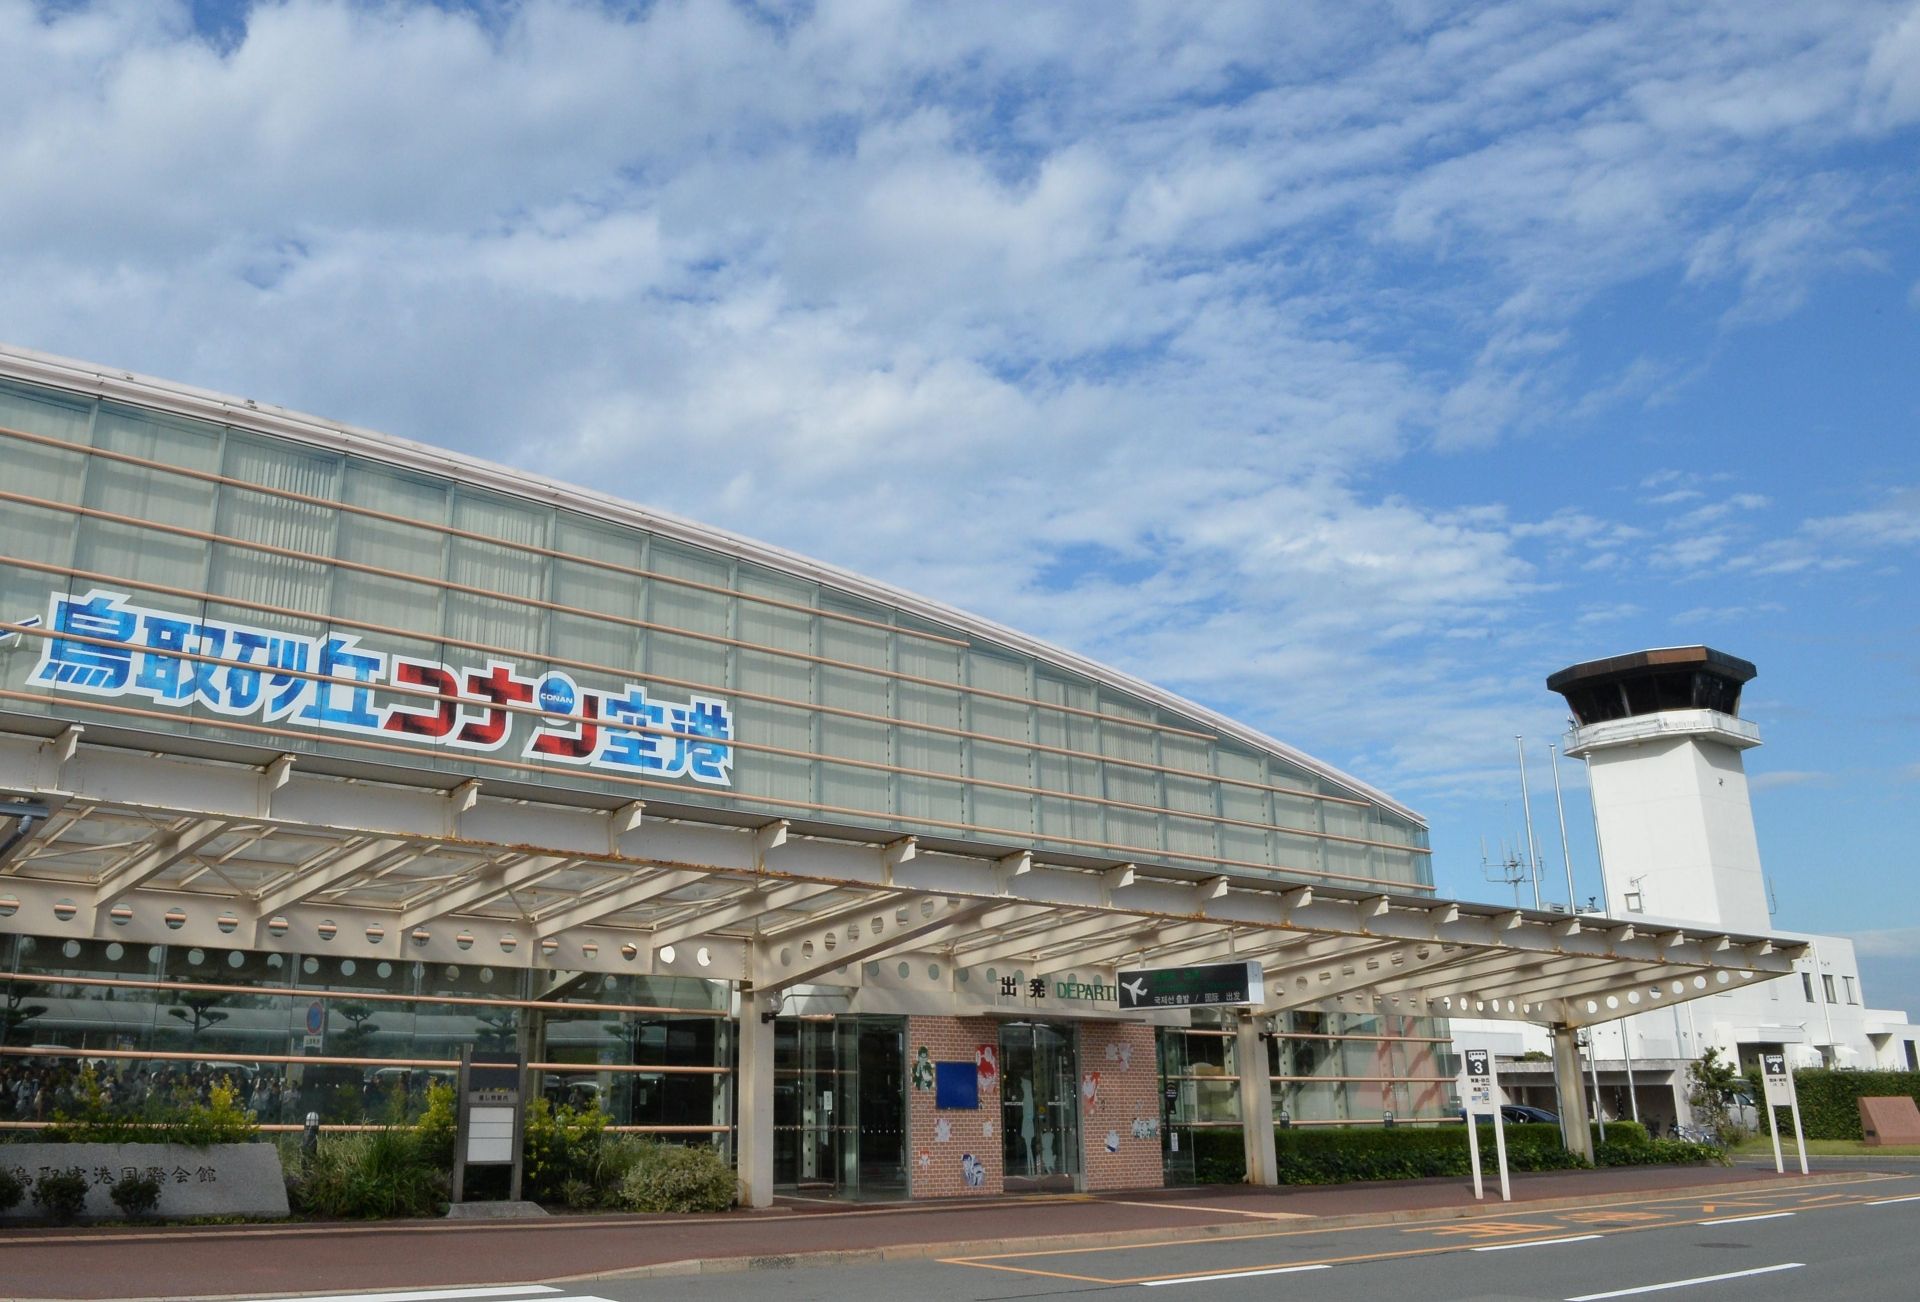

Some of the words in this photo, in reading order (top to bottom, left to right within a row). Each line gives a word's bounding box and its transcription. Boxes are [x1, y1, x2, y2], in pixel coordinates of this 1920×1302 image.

[32, 592, 731, 782] 鳥取砂丘コナン空港
[541, 693, 573, 704] CONAN
[1001, 976, 1047, 998] 出発
[1474, 1061, 1483, 1074] 3
[1772, 1063, 1780, 1074] 4
